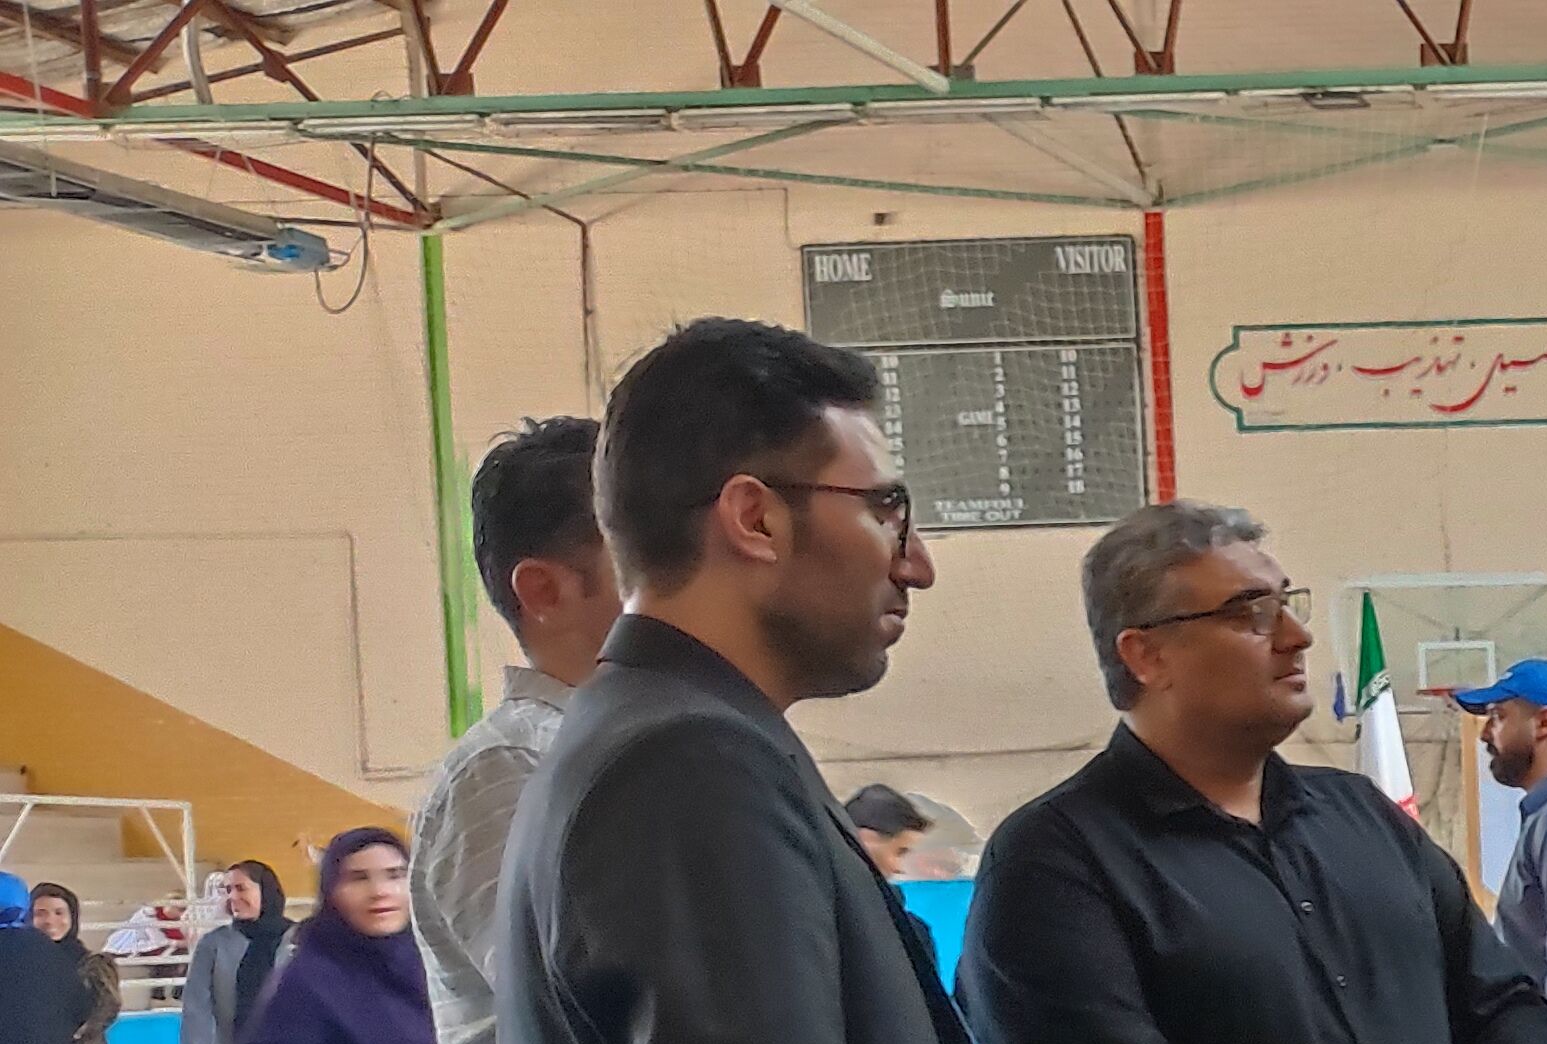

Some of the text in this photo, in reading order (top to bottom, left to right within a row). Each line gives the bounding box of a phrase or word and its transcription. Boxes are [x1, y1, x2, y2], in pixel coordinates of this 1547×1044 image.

[814, 253, 872, 283] HOME
[1055, 246, 1127, 274] VISITOR
[1240, 331, 1338, 398] ورزش
[984, 510, 1022, 521] OUT
